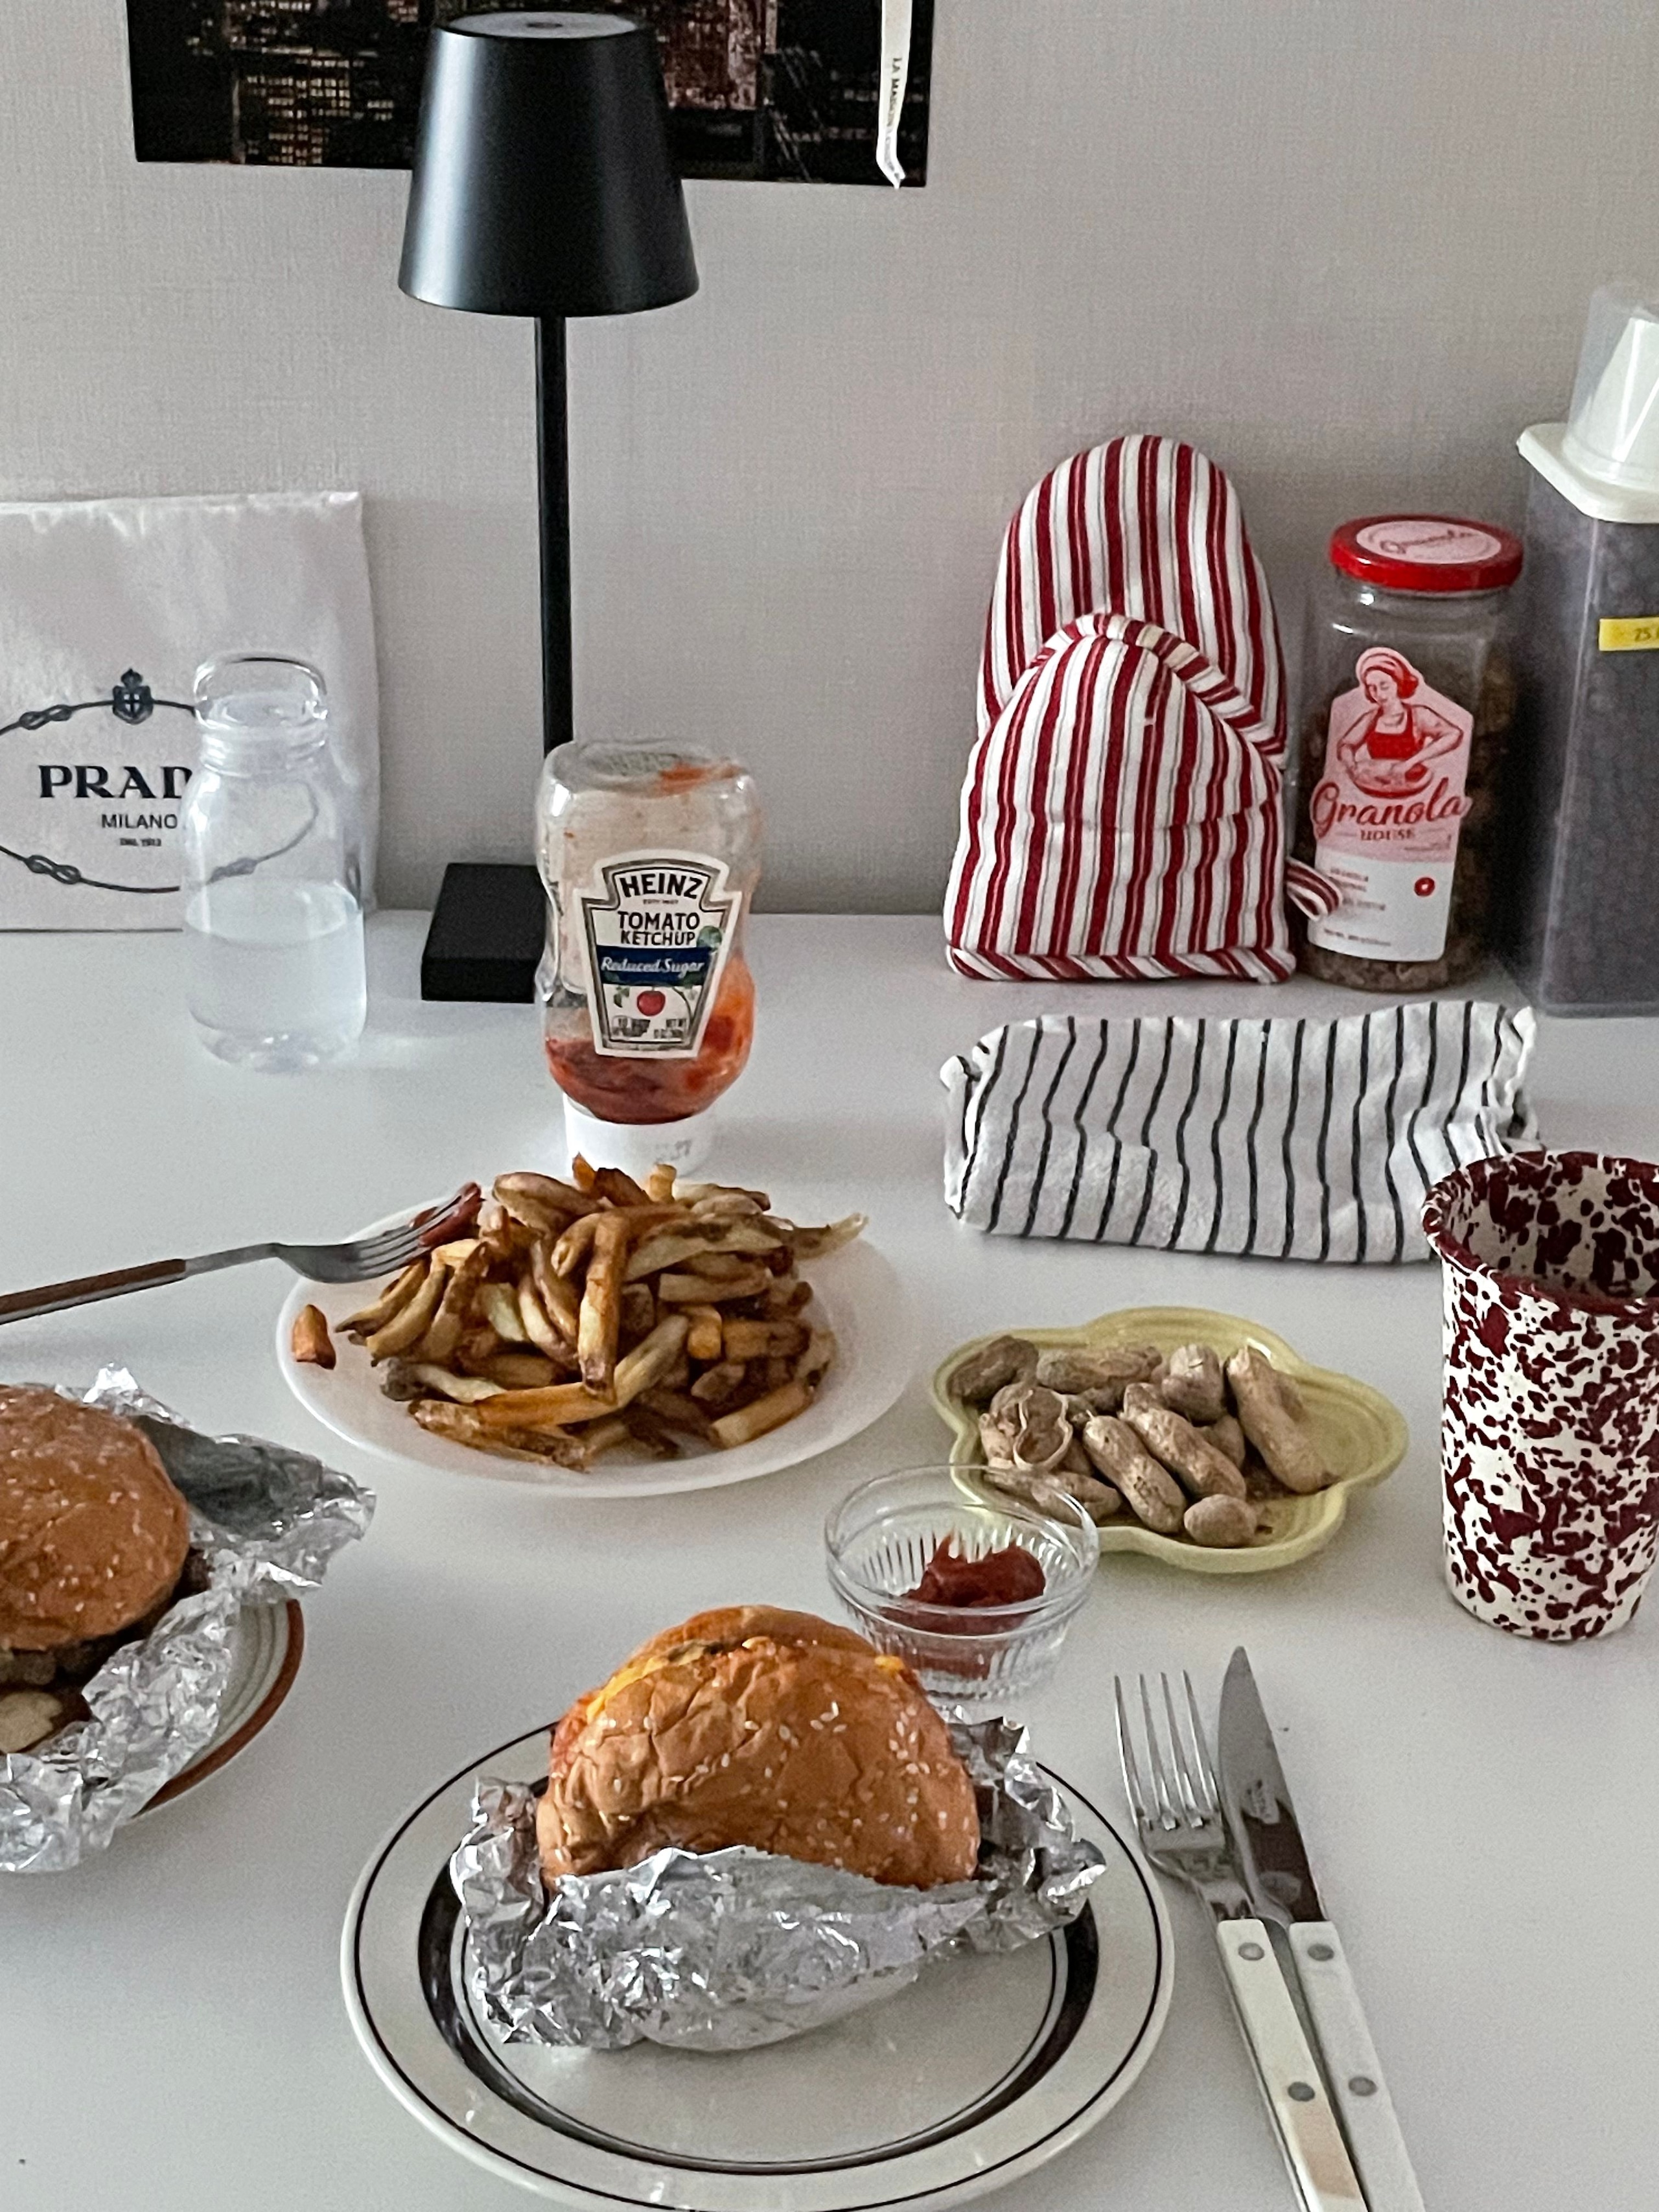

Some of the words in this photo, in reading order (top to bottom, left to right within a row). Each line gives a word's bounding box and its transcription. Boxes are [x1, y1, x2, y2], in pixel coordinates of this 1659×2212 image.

[38, 765, 193, 799] PRAD
[1313, 777, 1462, 838] Granola
[101, 813, 178, 830] MILANO
[620, 872, 703, 899] HEINZ
[618, 911, 700, 931] TOMATO
[620, 930, 696, 946] KETCHUP
[600, 956, 661, 973] Reduced
[660, 957, 705, 979] Sugar
